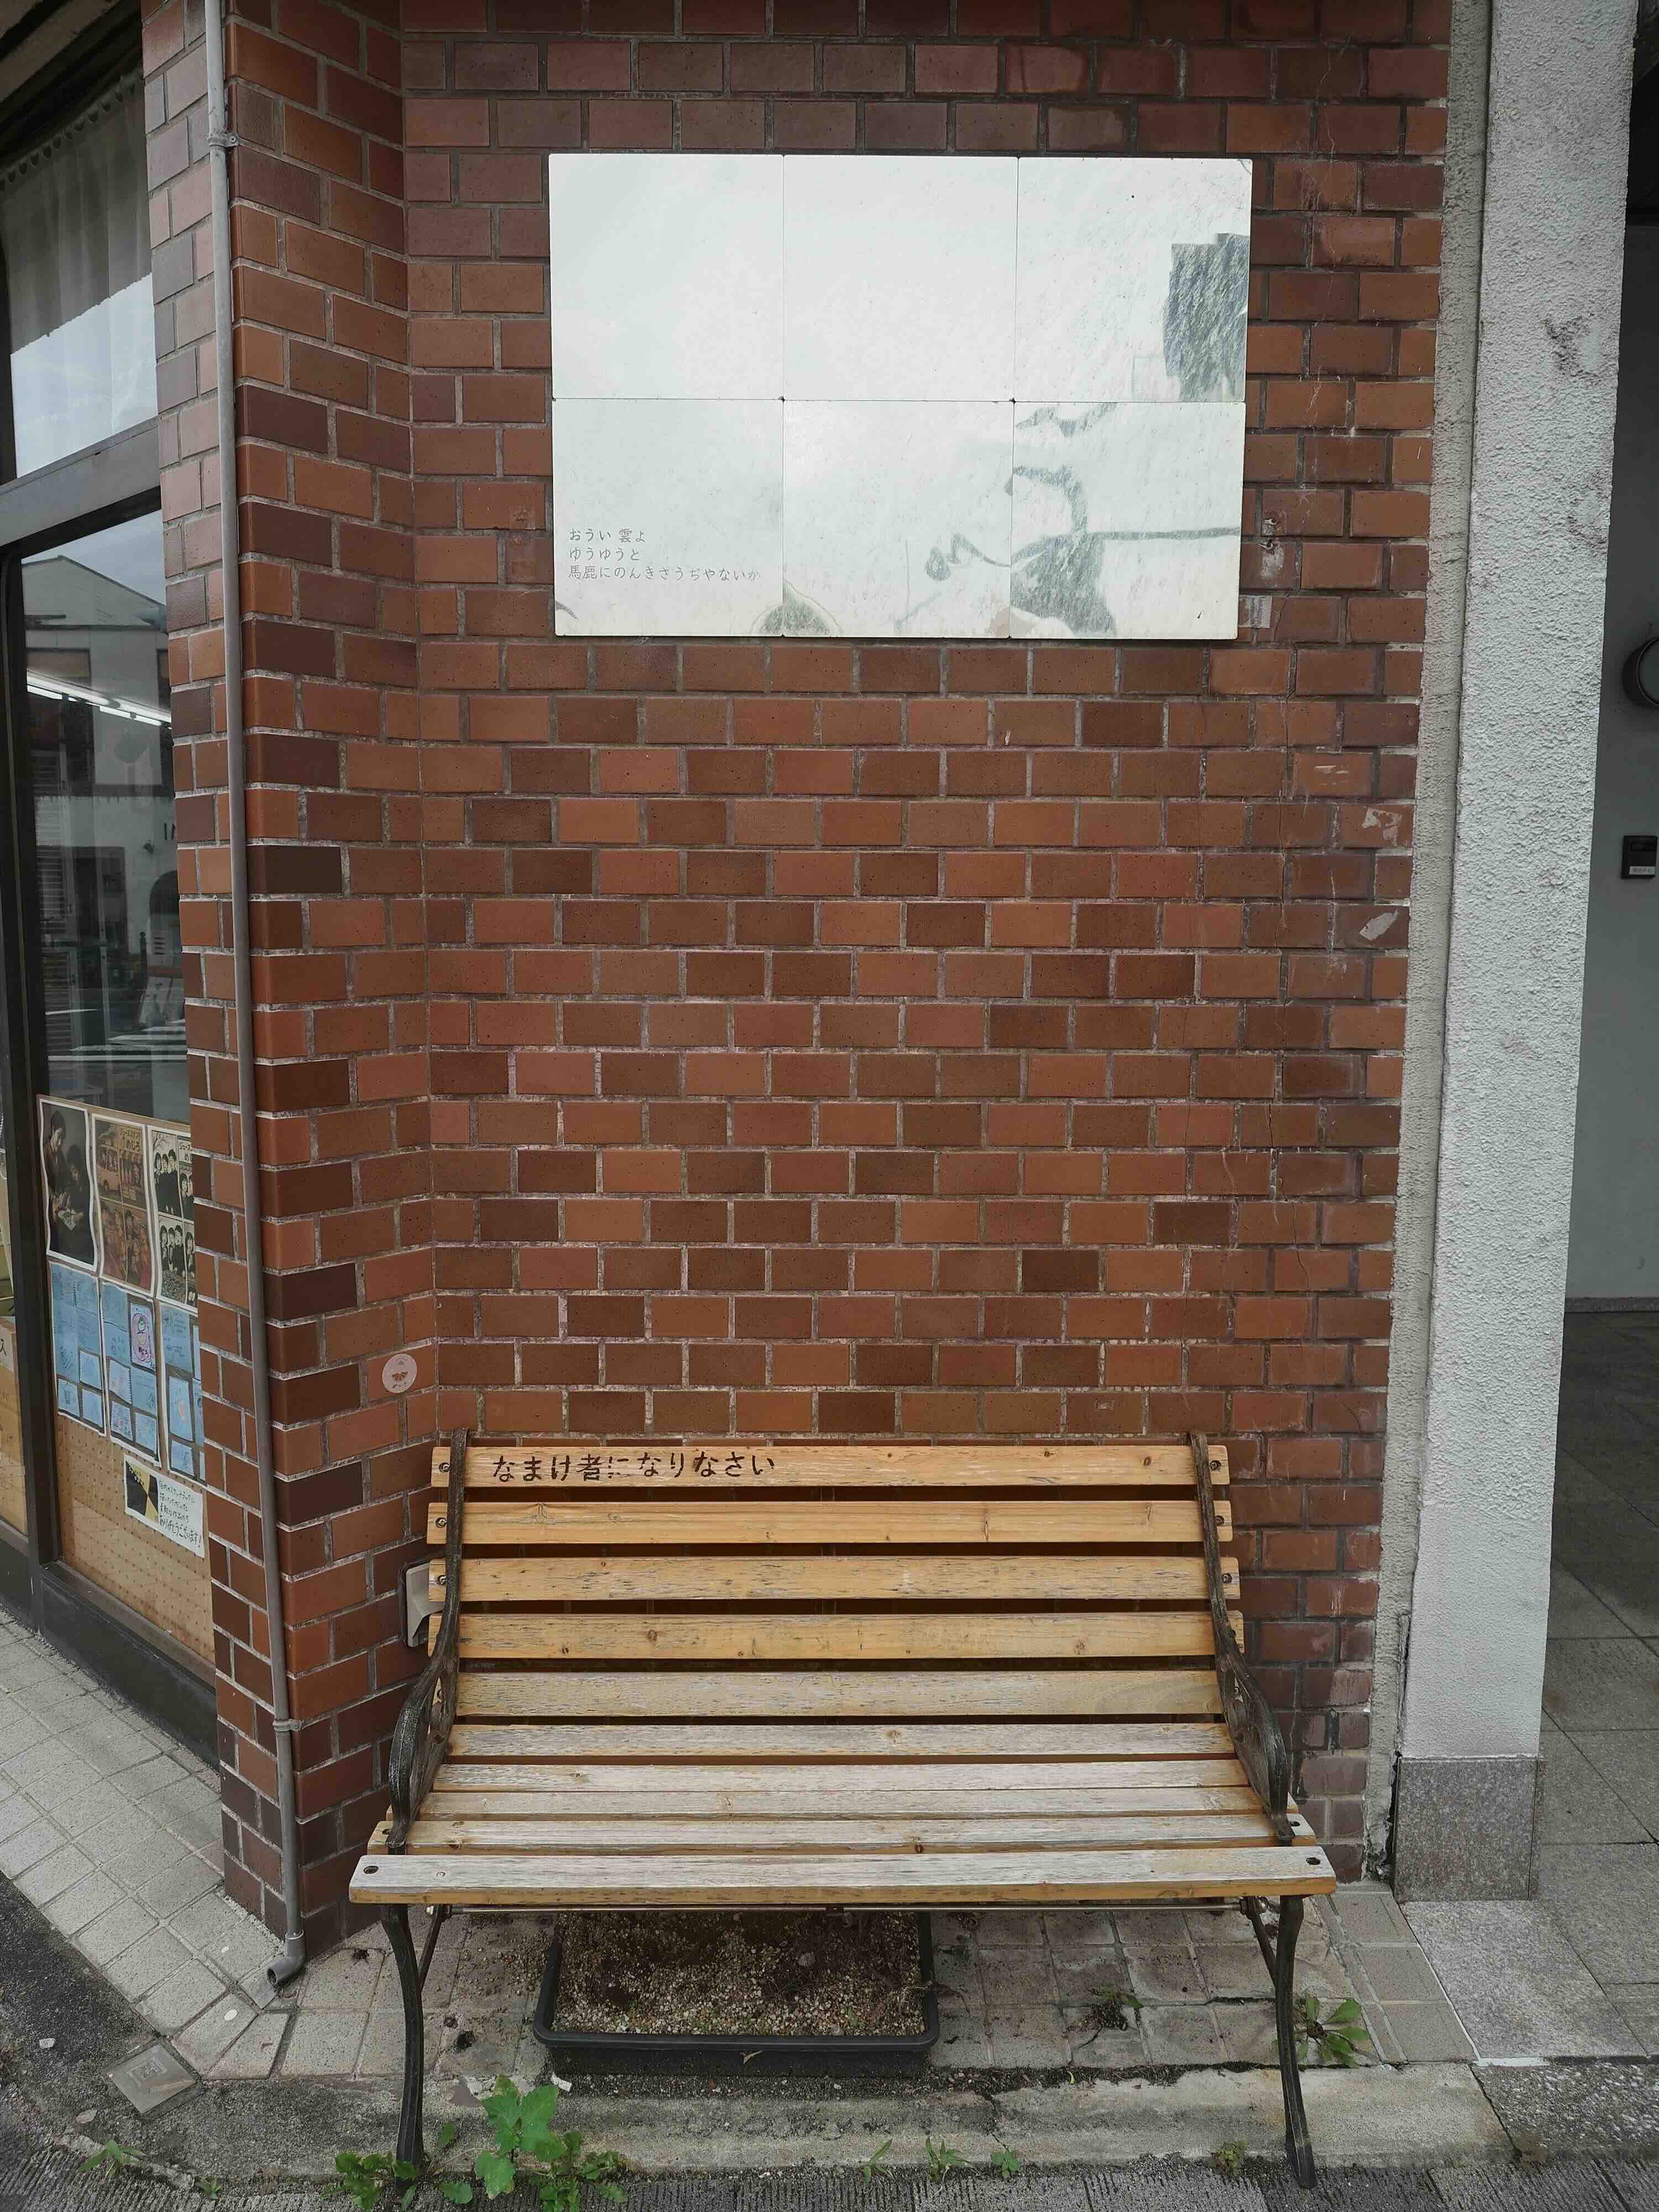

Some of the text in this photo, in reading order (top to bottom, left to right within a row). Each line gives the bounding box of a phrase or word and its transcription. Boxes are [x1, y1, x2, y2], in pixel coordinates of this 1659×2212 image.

[569, 547, 641, 561] ゆうゆうと
[568, 565, 761, 582] 馬鹿にのんきさうぢやないか
[493, 1452, 774, 1483] なまけ者になりなさい
